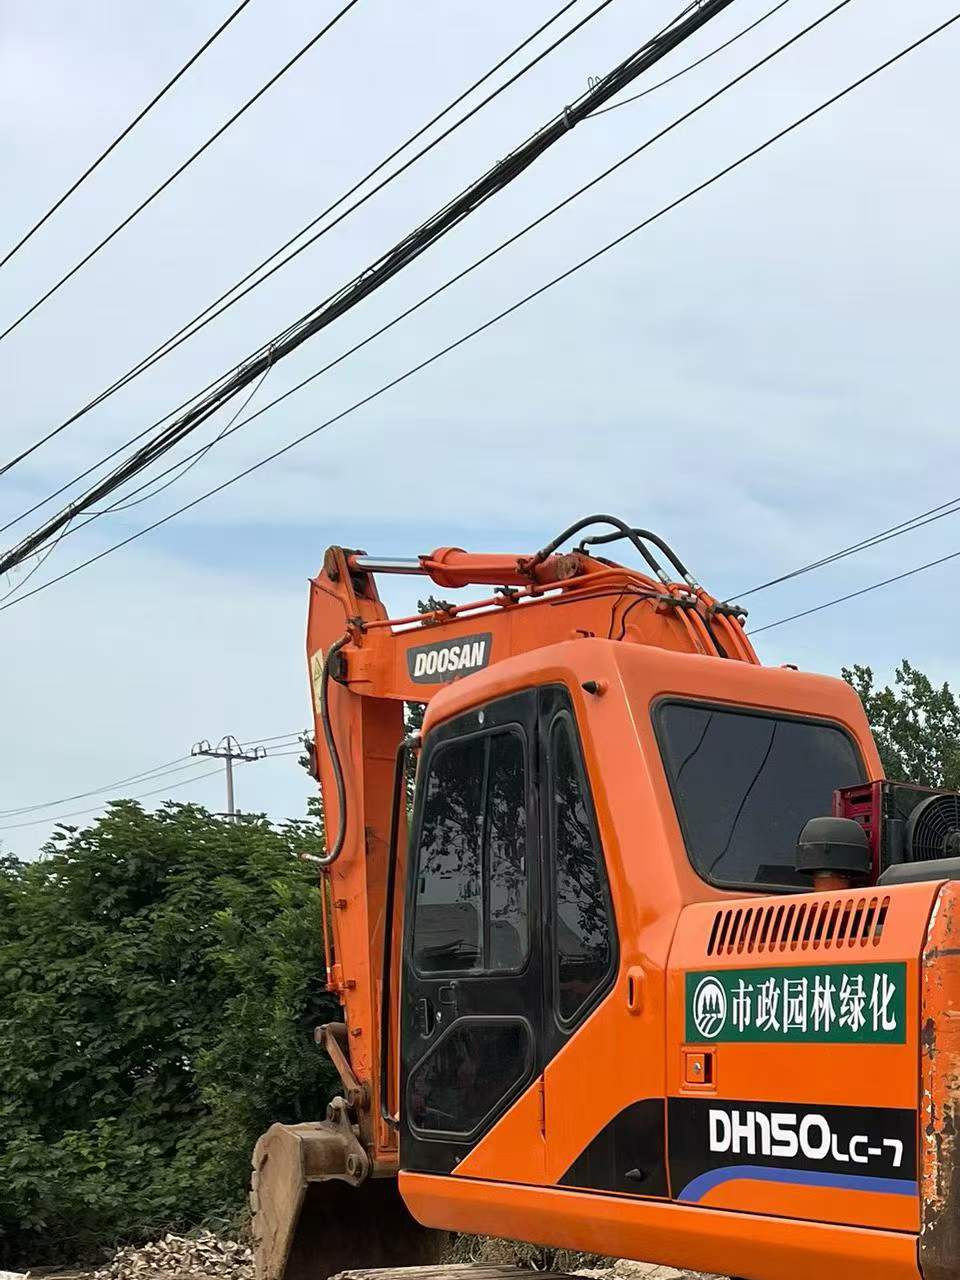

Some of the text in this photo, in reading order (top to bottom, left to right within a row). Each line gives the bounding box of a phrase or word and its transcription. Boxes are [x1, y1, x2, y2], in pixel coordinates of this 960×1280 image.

[414, 641, 486, 677] DOOSAN
[731, 973, 897, 1033] 市政园林绿化
